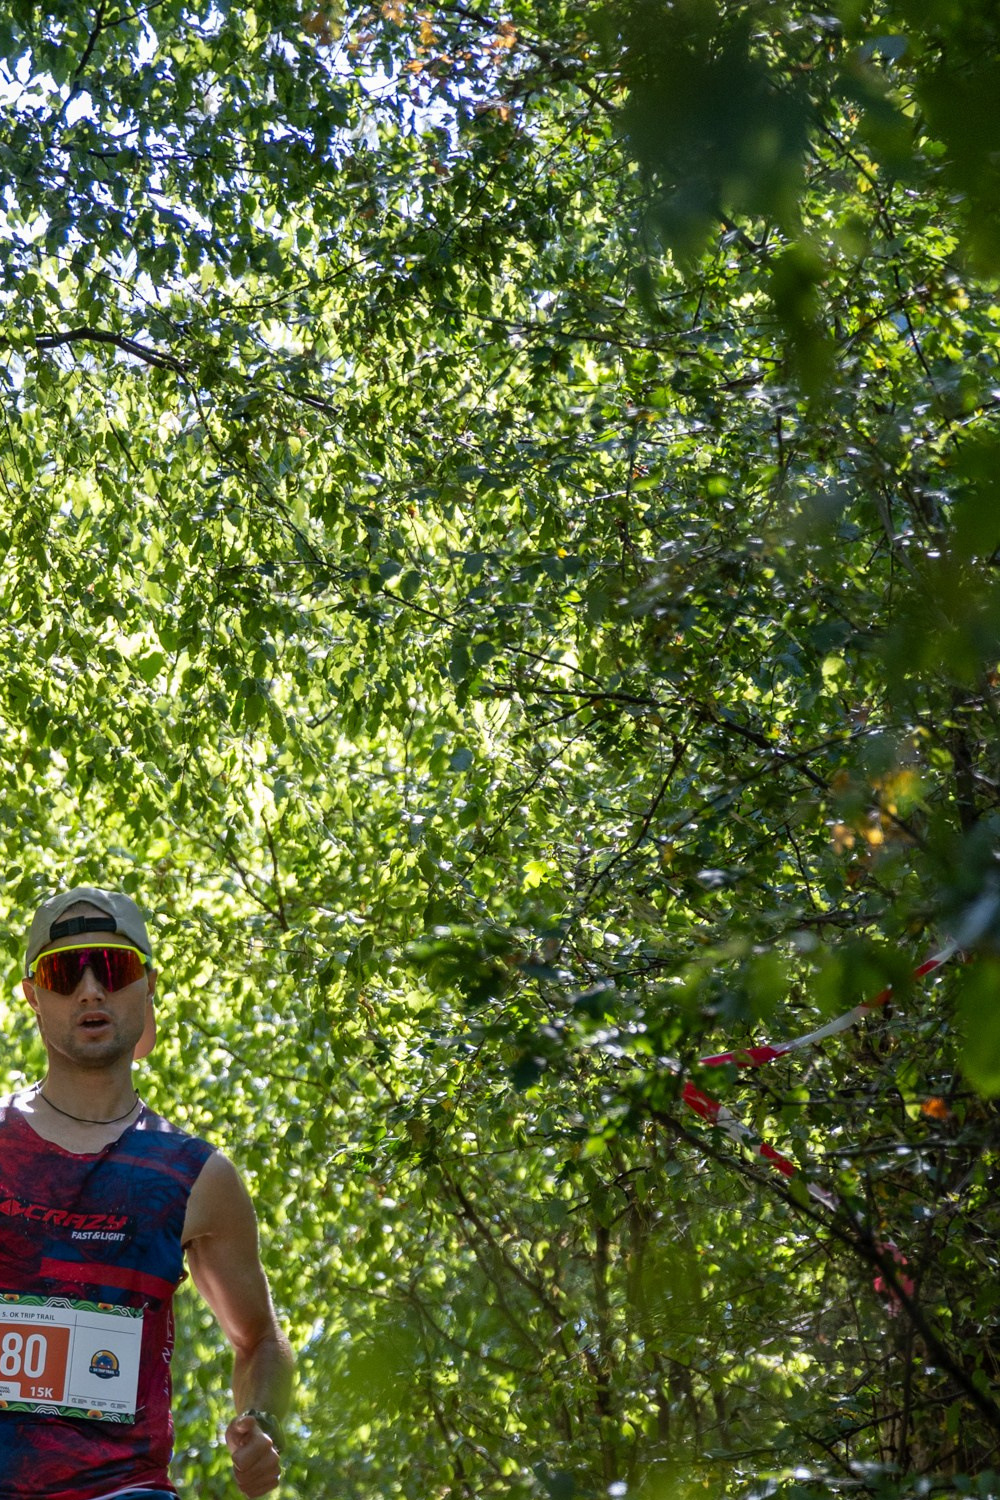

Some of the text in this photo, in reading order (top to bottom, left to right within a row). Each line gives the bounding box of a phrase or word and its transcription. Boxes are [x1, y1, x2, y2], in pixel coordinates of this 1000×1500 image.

[24, 1205, 128, 1231] CRAZY
[37, 1313, 55, 1321] TRAIL
[0, 1332, 48, 1379] 80
[30, 1386, 54, 1398] 15K
